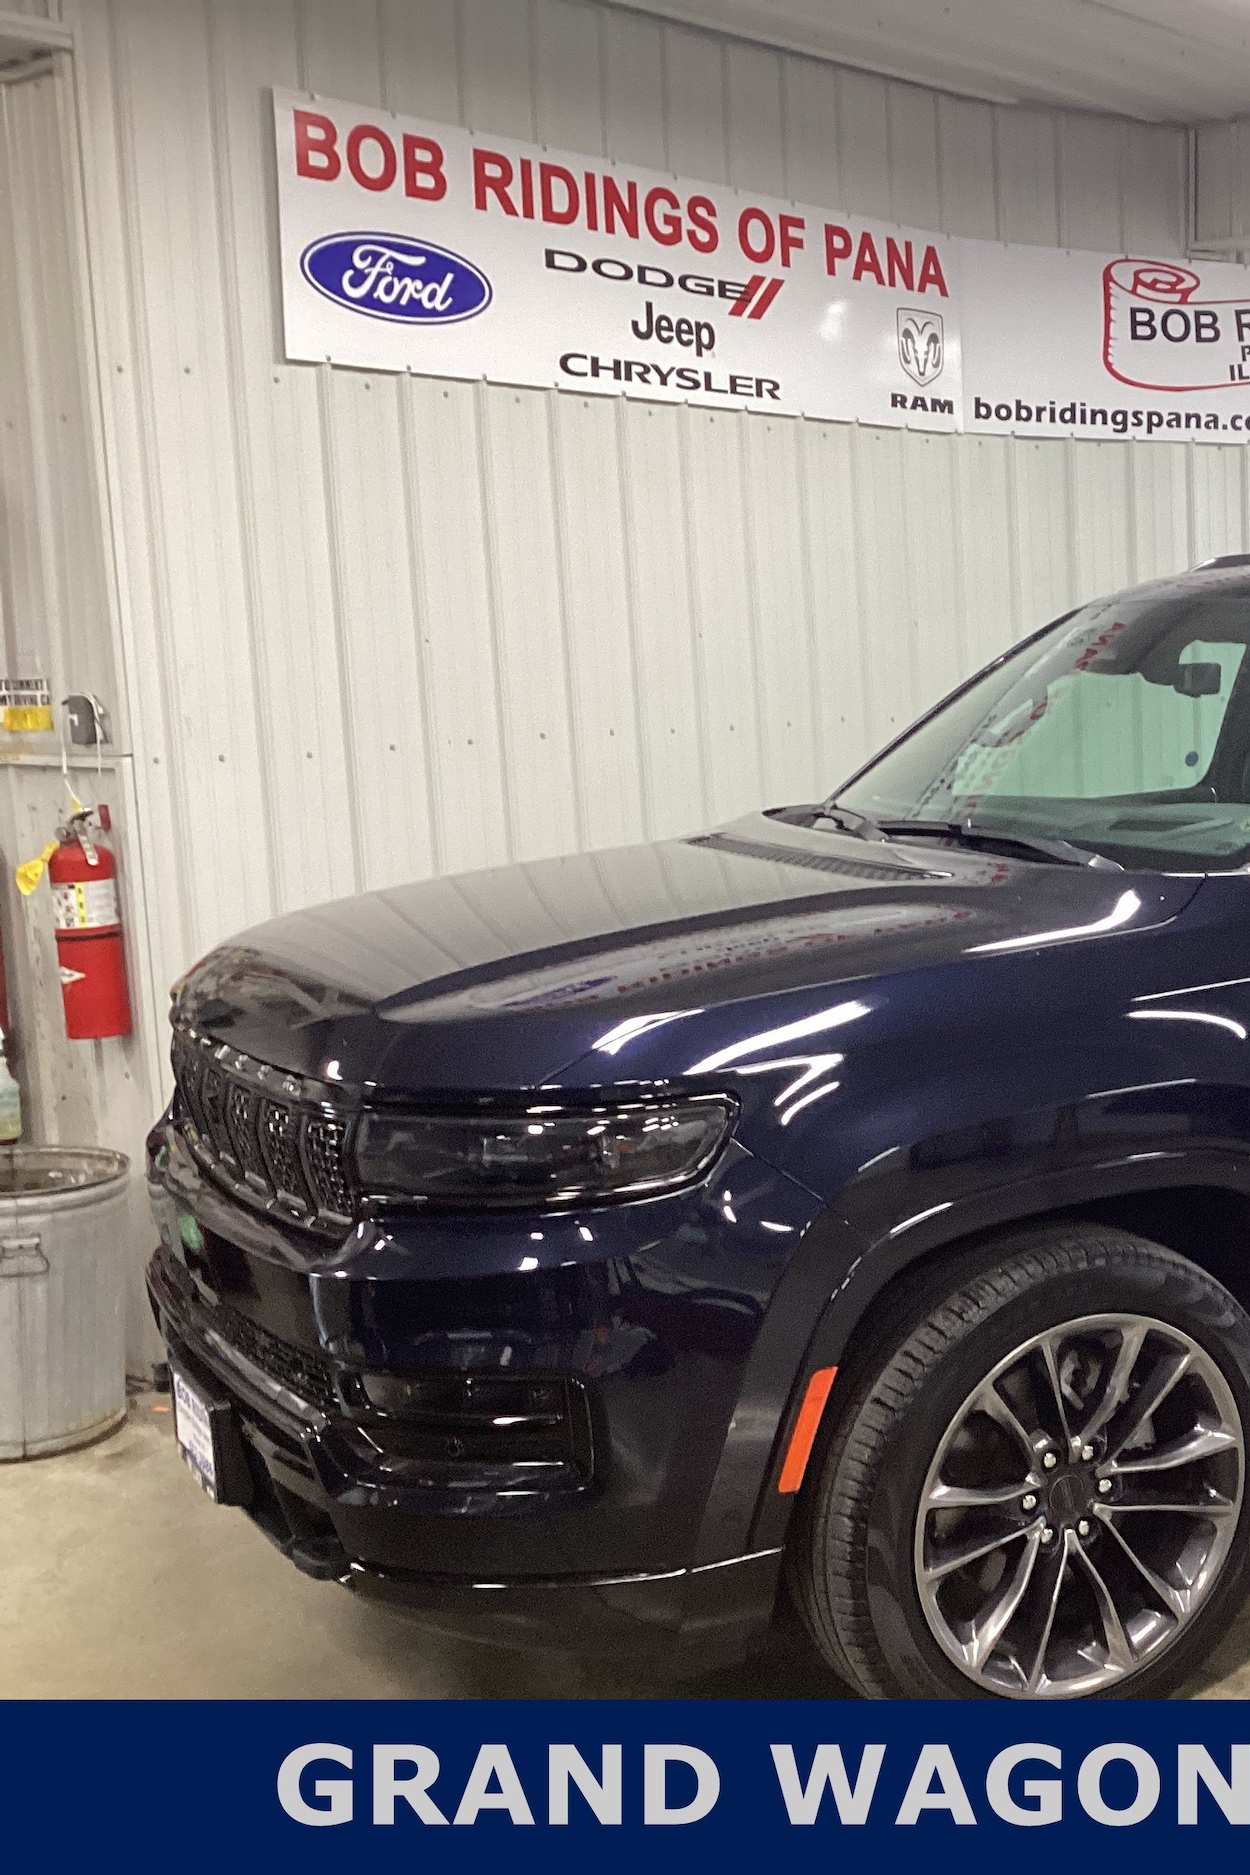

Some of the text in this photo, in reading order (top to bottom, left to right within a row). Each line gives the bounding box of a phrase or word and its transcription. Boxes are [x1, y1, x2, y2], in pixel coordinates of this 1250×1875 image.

[294, 111, 949, 297] BOB RIDINGS OF PANA
[340, 241, 455, 312] Ford
[545, 248, 751, 303] DODGE
[632, 301, 715, 356] Jeep
[1130, 306, 1221, 343] BOB
[559, 353, 781, 400] CHRYSLER
[891, 393, 954, 415] RAM
